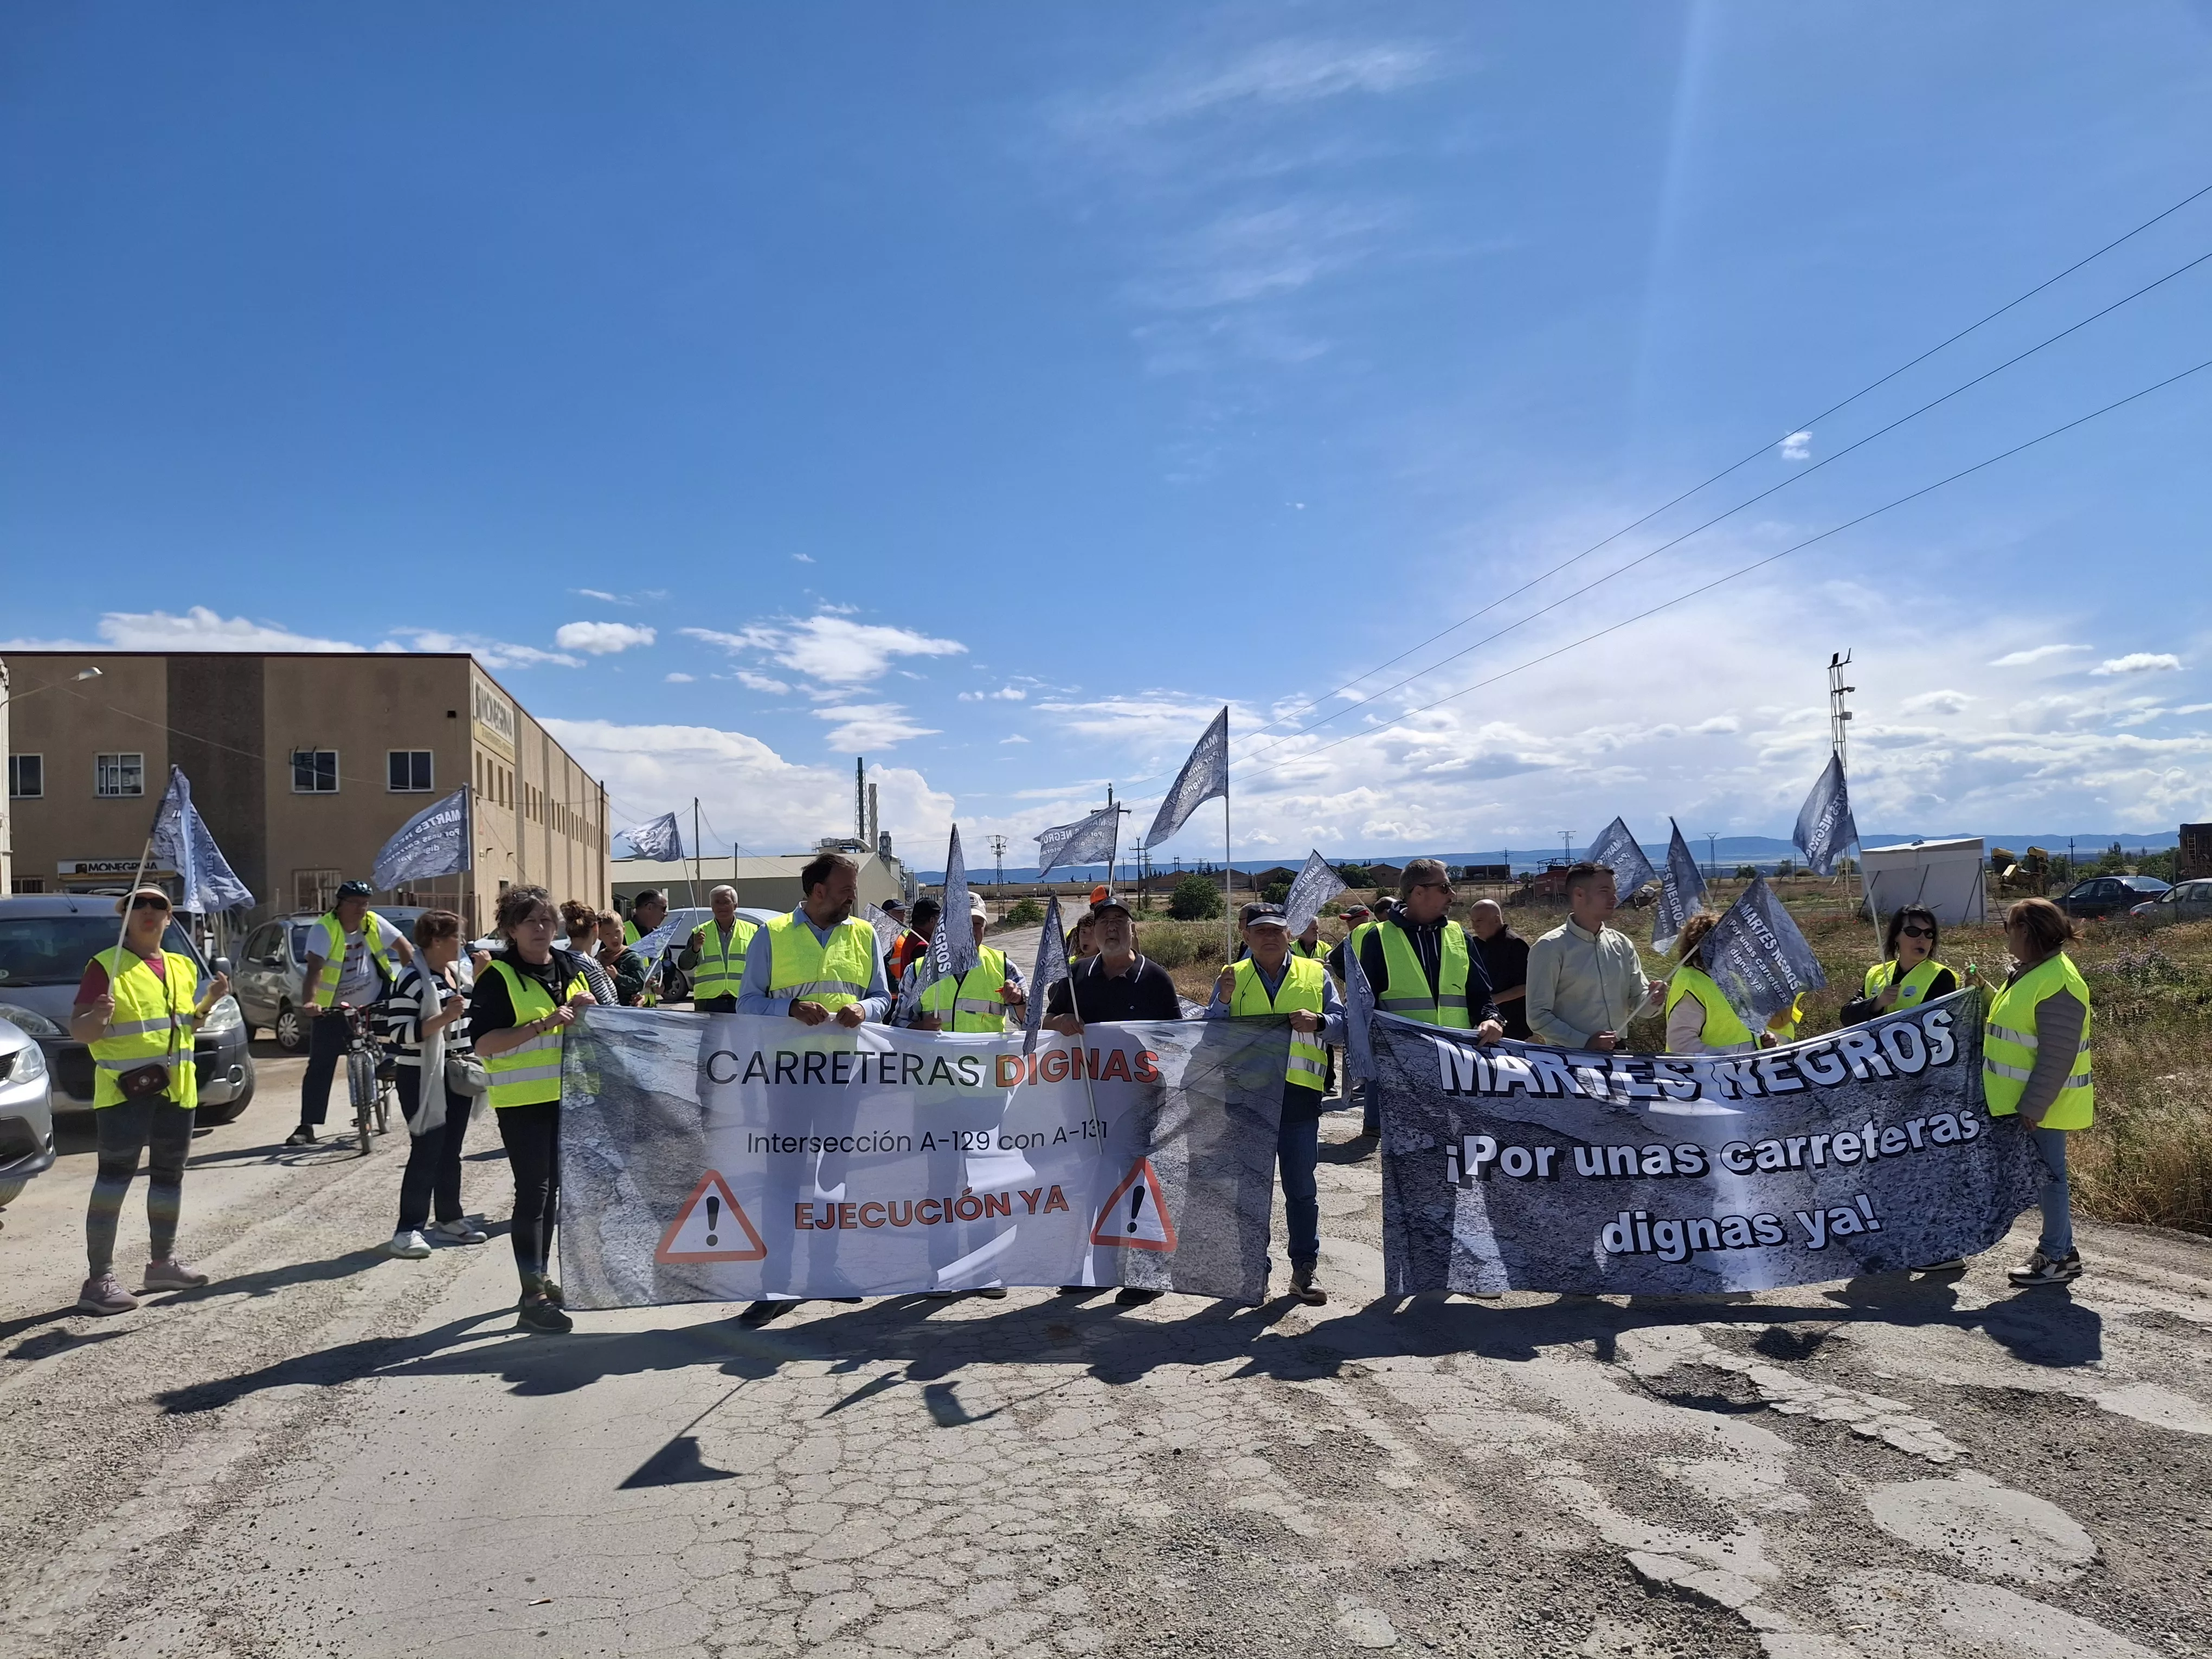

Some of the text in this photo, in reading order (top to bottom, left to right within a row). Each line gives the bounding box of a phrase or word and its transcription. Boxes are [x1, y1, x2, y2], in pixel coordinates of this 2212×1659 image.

[1726, 919, 1790, 1003] ¡Por unas carreteras
[1730, 948, 1766, 993] dignas ya!
[1739, 903, 1802, 991] MARTES NEGROS
[706, 1047, 1159, 1088] CARRETERAS DIGNAS
[1435, 1009, 1957, 1101] MARTES NEGROS
[748, 1118, 1108, 1153] Intersección A-129 con A-131
[1445, 1109, 1981, 1184] ¡Por unas carreteras
[795, 1185, 1070, 1230] EJECUCIÓN YA
[1601, 1194, 1883, 1263] dignas ya!
